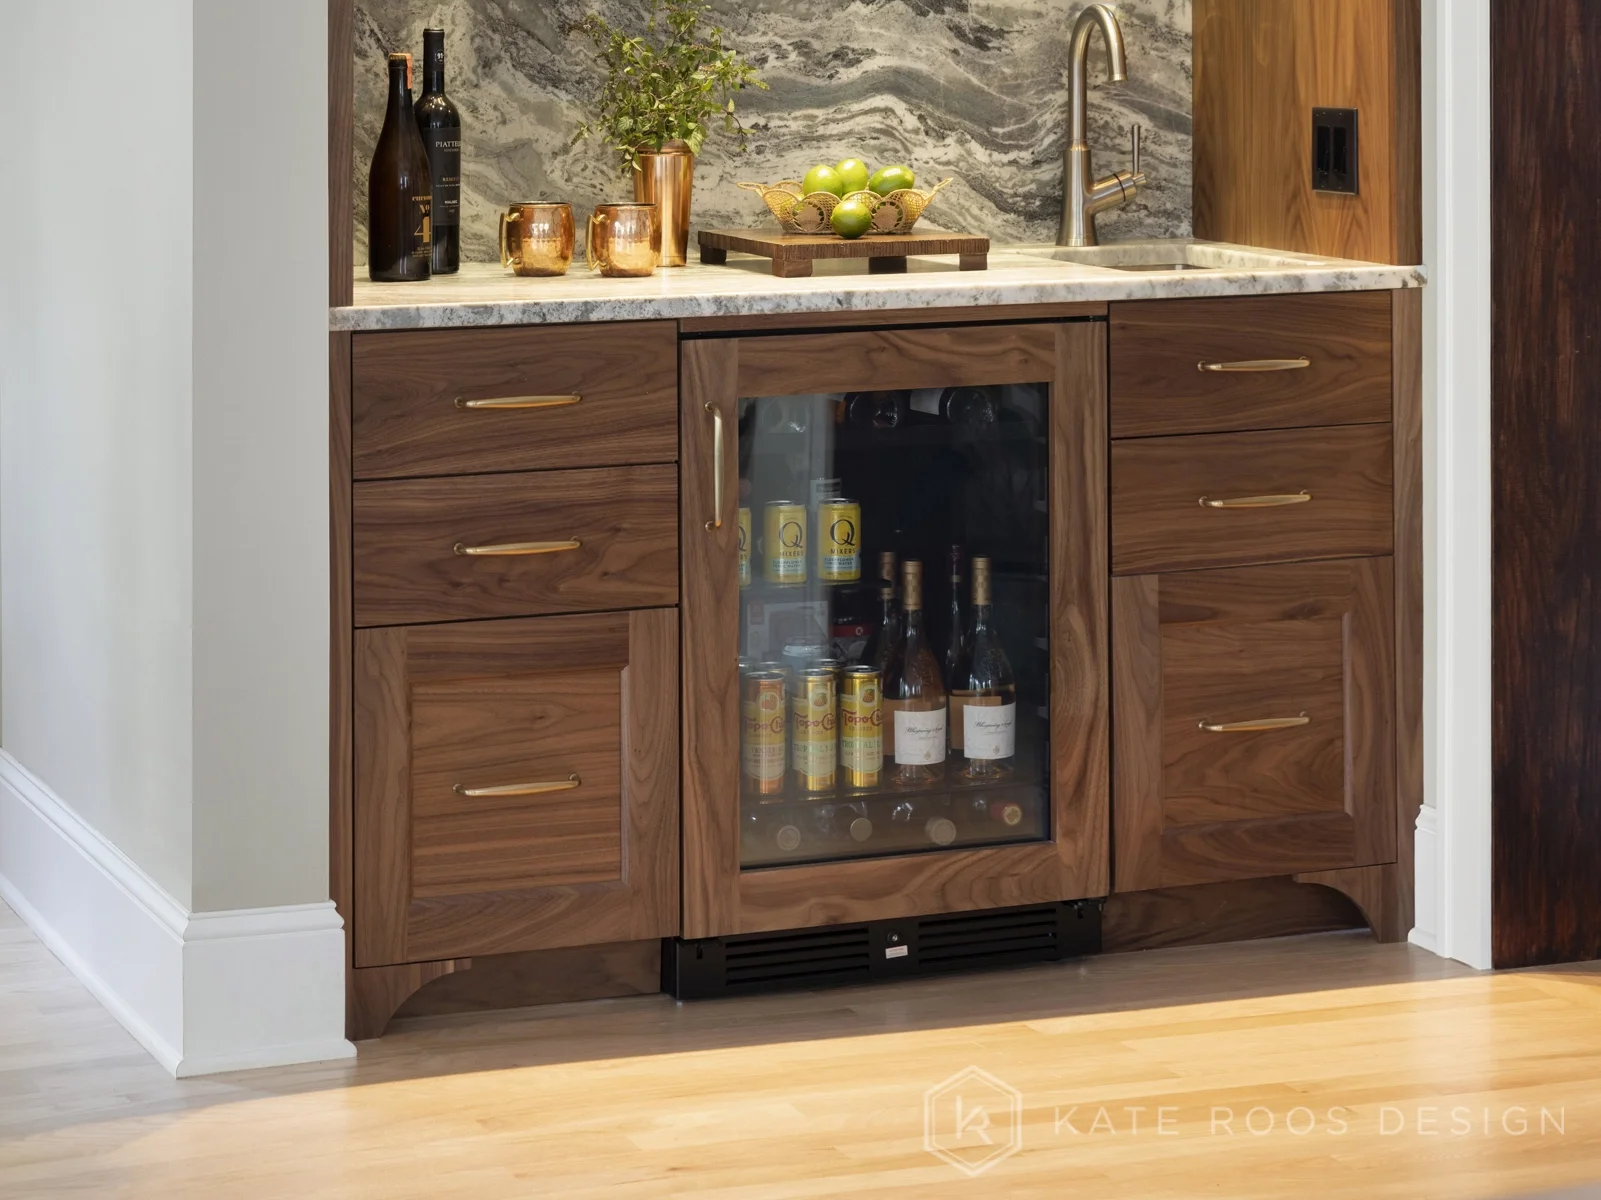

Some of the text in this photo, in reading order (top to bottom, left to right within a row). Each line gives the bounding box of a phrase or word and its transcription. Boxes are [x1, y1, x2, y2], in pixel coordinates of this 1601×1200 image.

[778, 521, 804, 549] Q
[830, 518, 855, 546] Q
[744, 715, 769, 732] Topo
[794, 712, 820, 730] Topo
[842, 709, 870, 726] Topo
